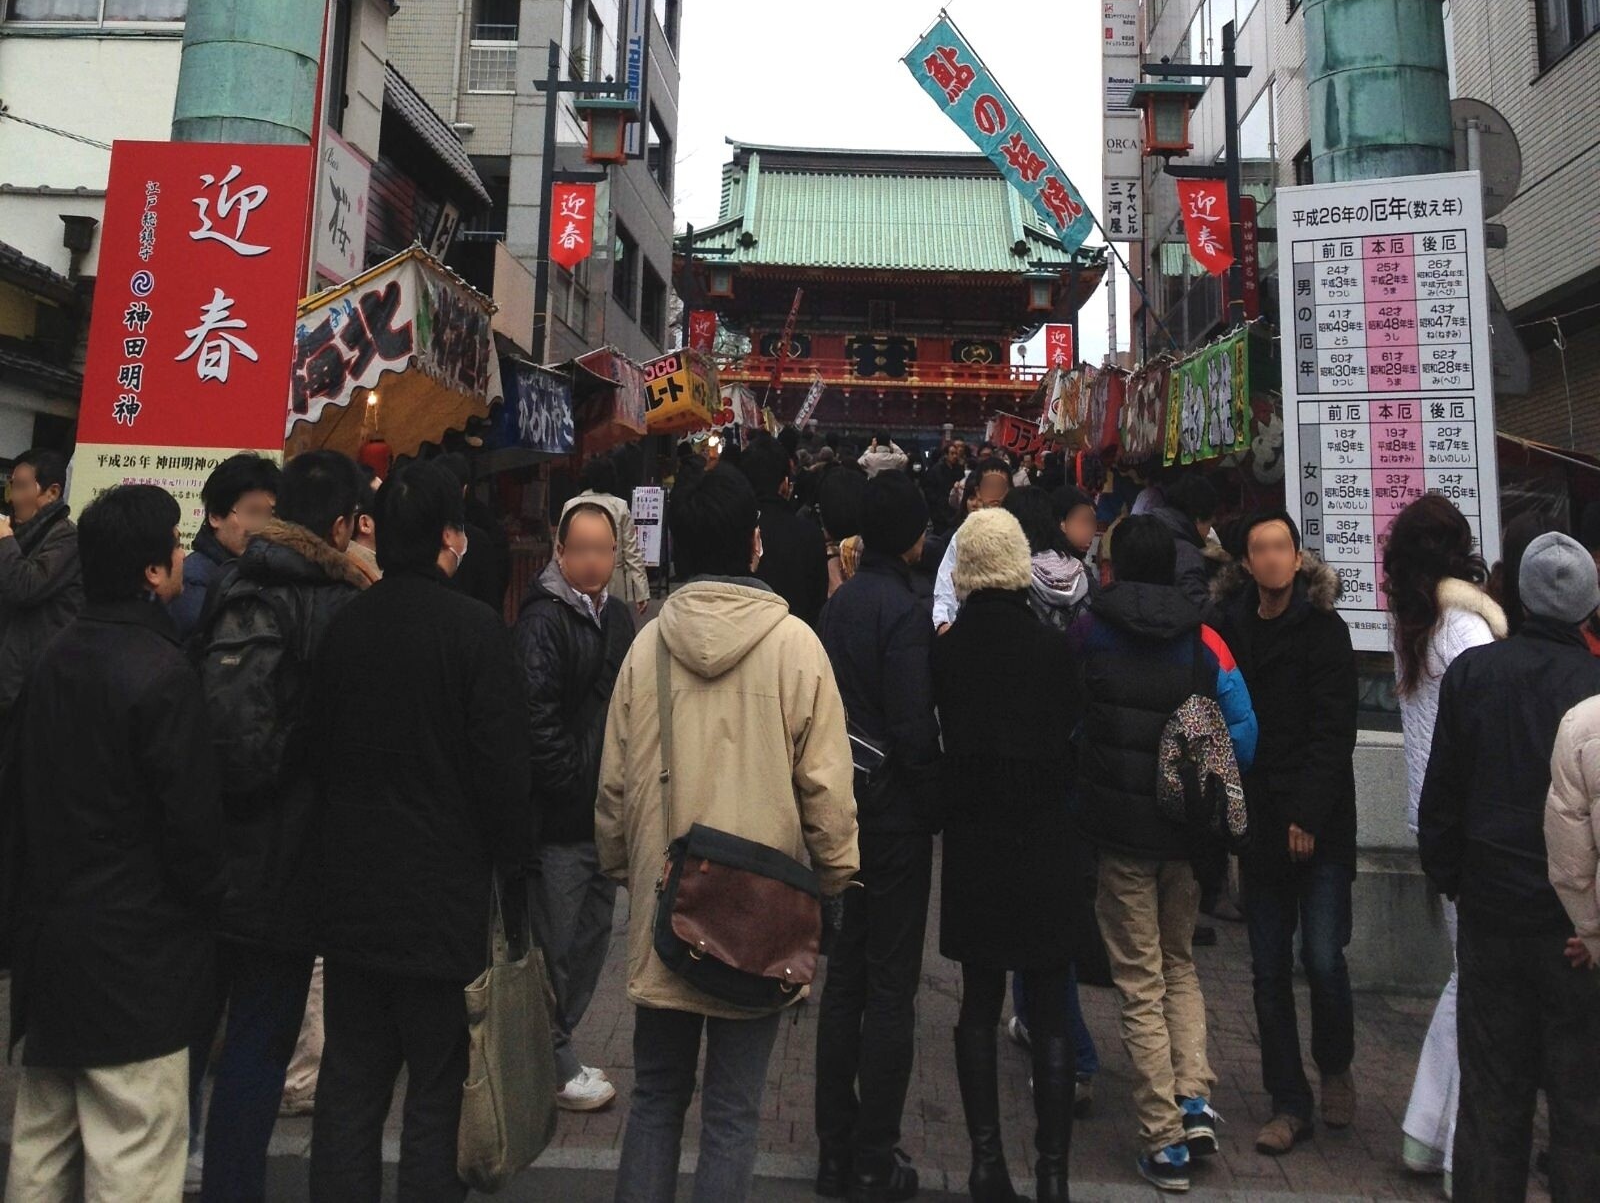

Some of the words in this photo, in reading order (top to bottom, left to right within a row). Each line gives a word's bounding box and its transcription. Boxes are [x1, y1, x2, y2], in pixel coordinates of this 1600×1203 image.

[923, 45, 1084, 232] 鮎の塩焼
[1106, 138, 1137, 149] ORCA
[1108, 182, 1123, 234] 三河屋
[1127, 182, 1138, 234] アヤベビル
[1293, 197, 1463, 228] 平成26年の厄年(数え年)
[139, 181, 160, 261] 江戸総鎮守
[558, 192, 586, 249] 迎春
[1189, 190, 1223, 257] 迎春
[1372, 239, 1404, 254] 本厄
[1423, 235, 1457, 251] 後厄
[1322, 242, 1354, 258] 前厄
[1327, 266, 1349, 275] 24才
[1377, 262, 1400, 272] 25才
[1428, 260, 1452, 269] 26才
[175, 165, 271, 383] 迎春
[1370, 274, 1409, 286] 平成2年生
[1321, 277, 1358, 288] 平成3年生
[1328, 309, 1352, 319] 41才
[1378, 307, 1401, 317] 42才
[1430, 304, 1455, 314] 43才
[1297, 279, 1315, 377] 男の厄年
[1318, 321, 1363, 333] 昭和49年生
[1368, 318, 1415, 330] 昭和48年生
[1419, 316, 1468, 328] 昭和47年生
[1050, 330, 1068, 364] 迎春
[1331, 354, 1353, 364] 60才
[1381, 351, 1404, 361] 61才
[1432, 350, 1457, 360] 62才
[112, 302, 153, 427] 神田明神
[1320, 364, 1366, 377] 昭和30年生
[1371, 362, 1418, 375] 昭和29年生
[1422, 361, 1471, 374] 昭和28年生
[1328, 404, 1361, 421] 前厄
[1378, 403, 1413, 419] 本厄
[1430, 402, 1465, 419] 後厄
[1335, 429, 1356, 439] 18才
[1385, 428, 1408, 438] 19才
[1438, 427, 1462, 437] 20才
[1327, 439, 1365, 452] 平成9年生
[1377, 439, 1417, 451] 平成8年生
[1429, 438, 1469, 451] 平成7年生
[97, 454, 151, 469] 平成26年
[156, 456, 227, 471] 神田明神の
[1335, 475, 1358, 484] 32才
[1386, 474, 1410, 484] 33才
[1438, 474, 1463, 484] 34才
[1325, 486, 1371, 499] 昭和58年生
[1375, 486, 1422, 498] 昭和57年生
[1337, 521, 1360, 530] 36才
[1326, 532, 1372, 544] 昭和54年生
